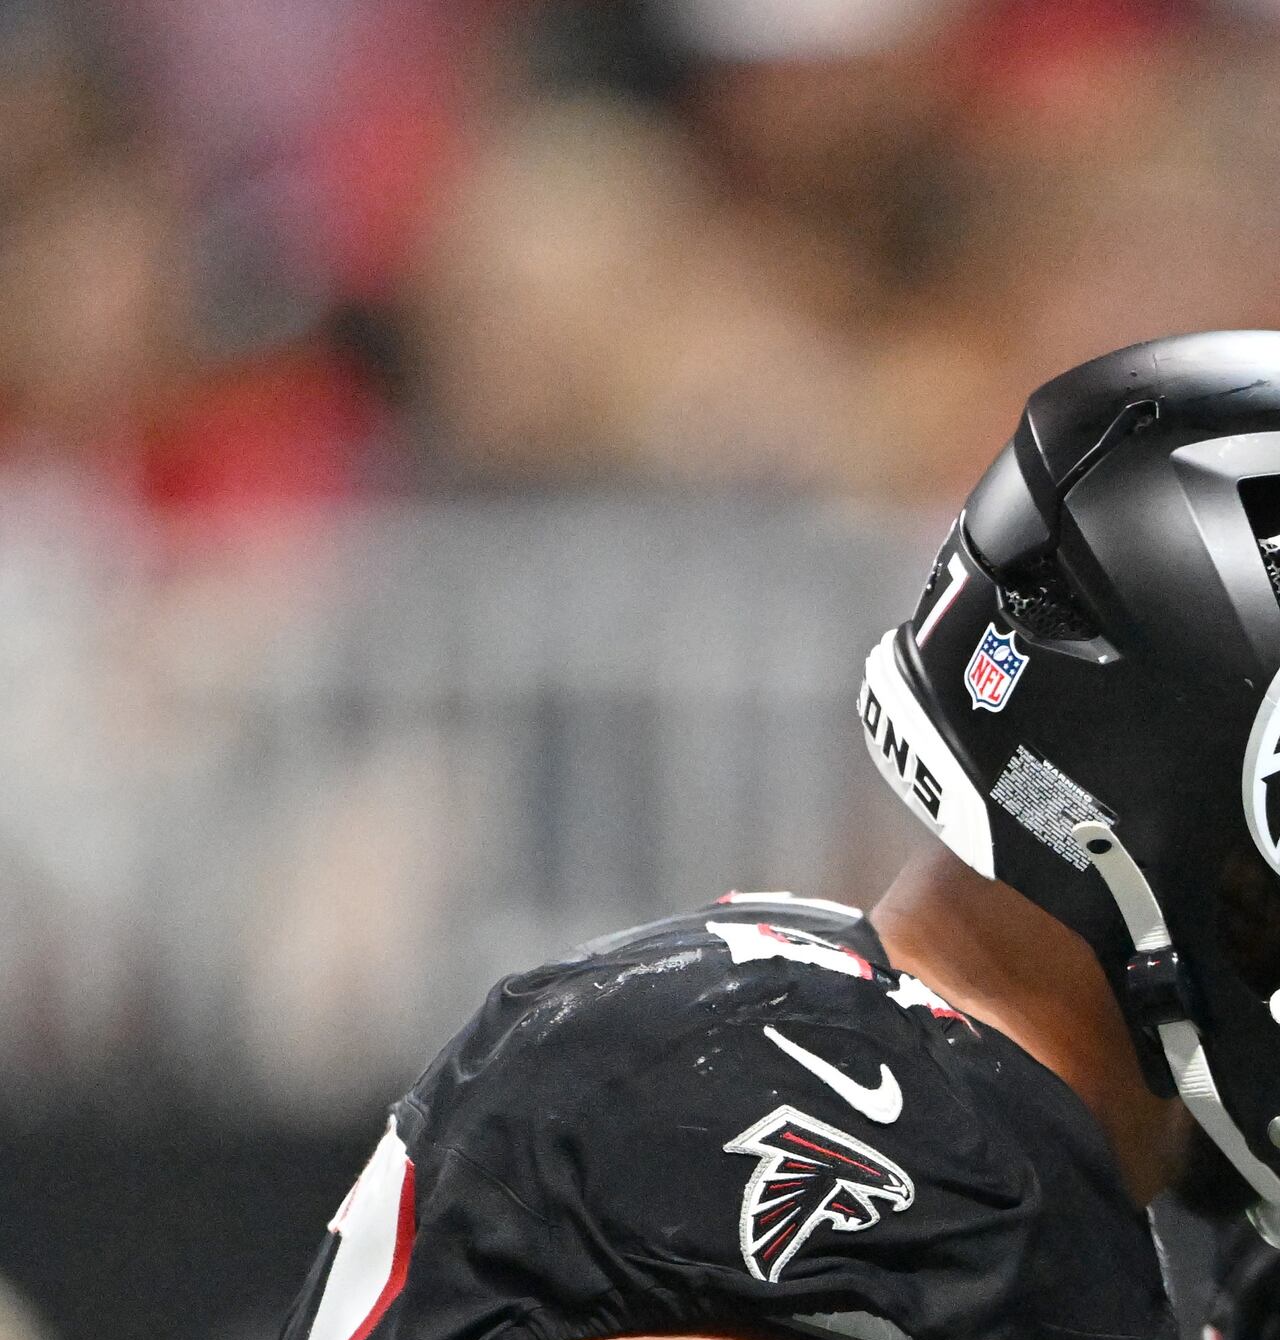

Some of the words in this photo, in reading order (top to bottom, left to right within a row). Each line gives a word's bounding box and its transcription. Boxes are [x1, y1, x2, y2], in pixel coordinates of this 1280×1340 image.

[970, 654, 1006, 702] NFL
[861, 684, 943, 821] ONS
[1041, 759, 1093, 802] WARNING
